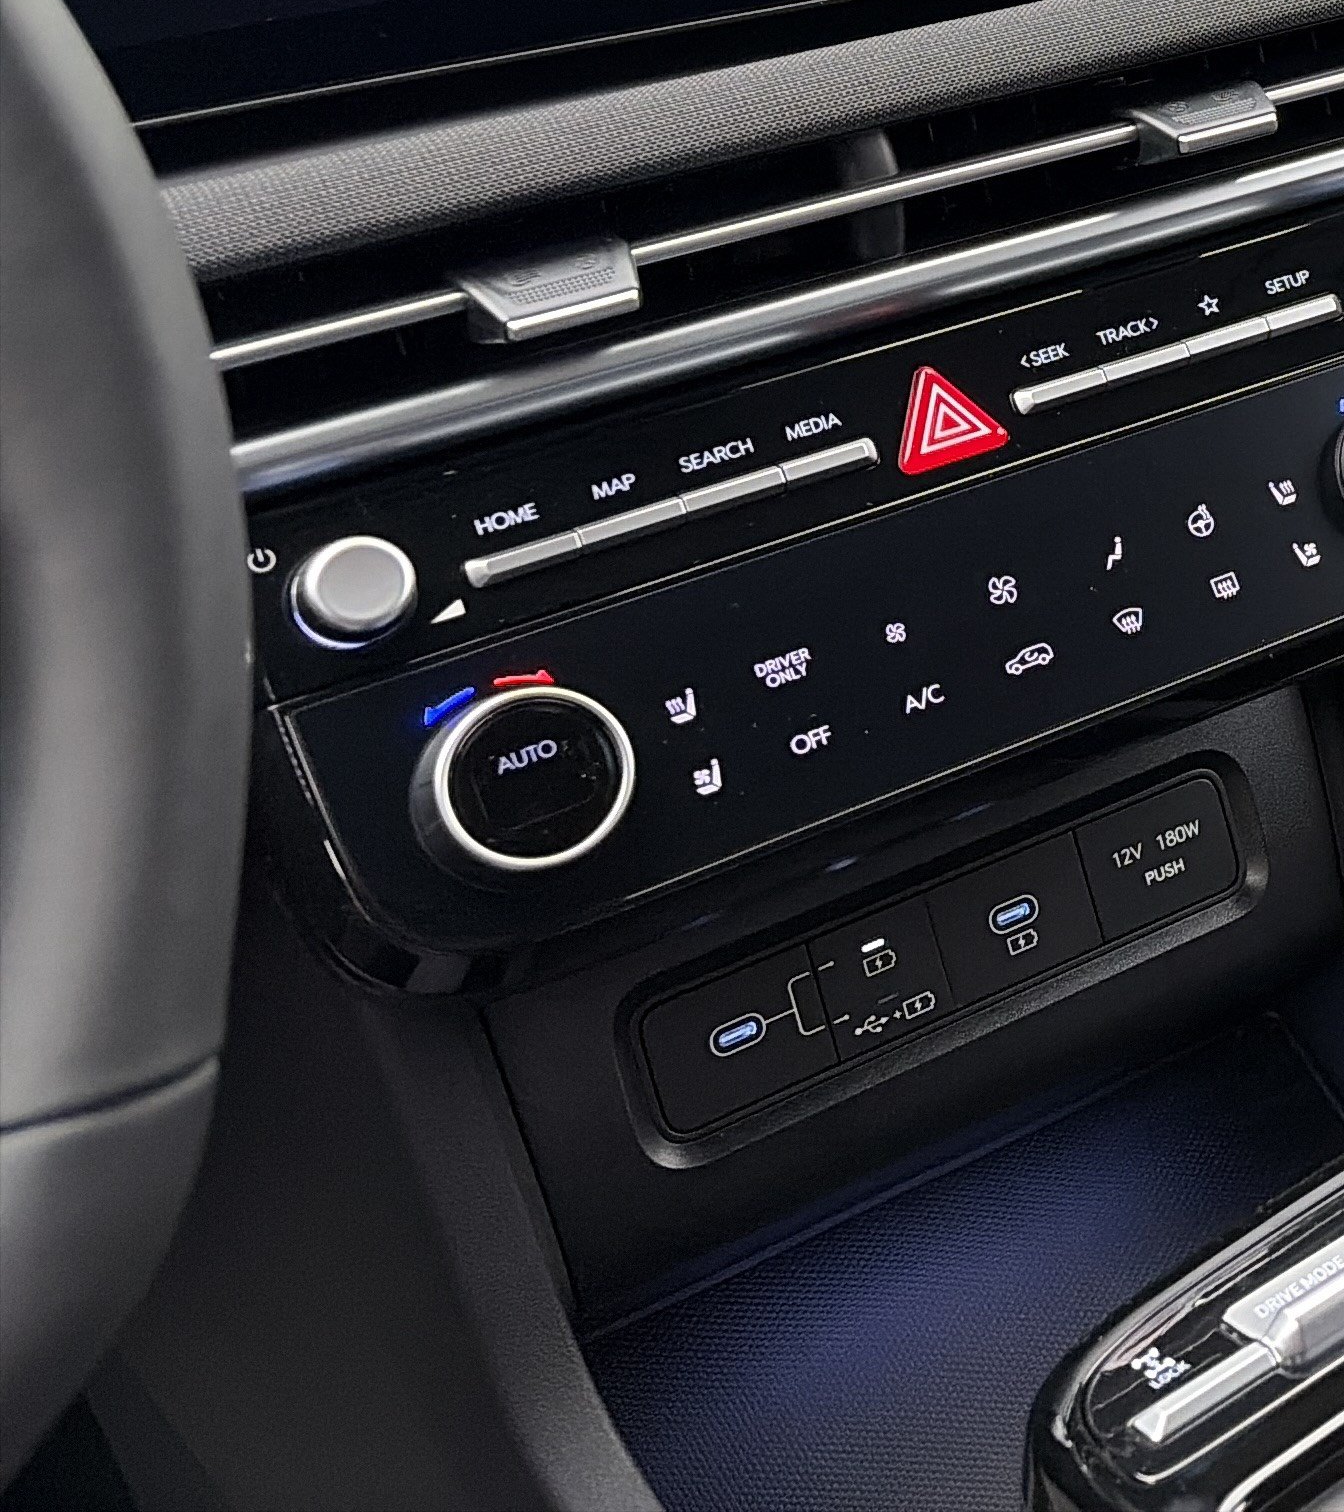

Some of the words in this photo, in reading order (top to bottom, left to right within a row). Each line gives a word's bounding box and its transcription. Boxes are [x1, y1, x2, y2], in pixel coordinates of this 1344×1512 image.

[1265, 271, 1311, 295] SETUP
[784, 413, 843, 442] MEDIA
[678, 438, 755, 475] SEARCH
[591, 473, 637, 501] MAP
[473, 502, 540, 536] HOME
[753, 647, 811, 679] DRIVER
[765, 660, 809, 689] ONLY
[904, 684, 946, 715] A/C
[790, 725, 831, 755] OFF
[496, 739, 558, 776] AUTO
[1112, 843, 1143, 870] 12V
[1155, 820, 1201, 851] 180W
[1144, 857, 1187, 887] PUSH
[1254, 1287, 1302, 1320] DRIVE
[1149, 1360, 1192, 1389] LOCK
